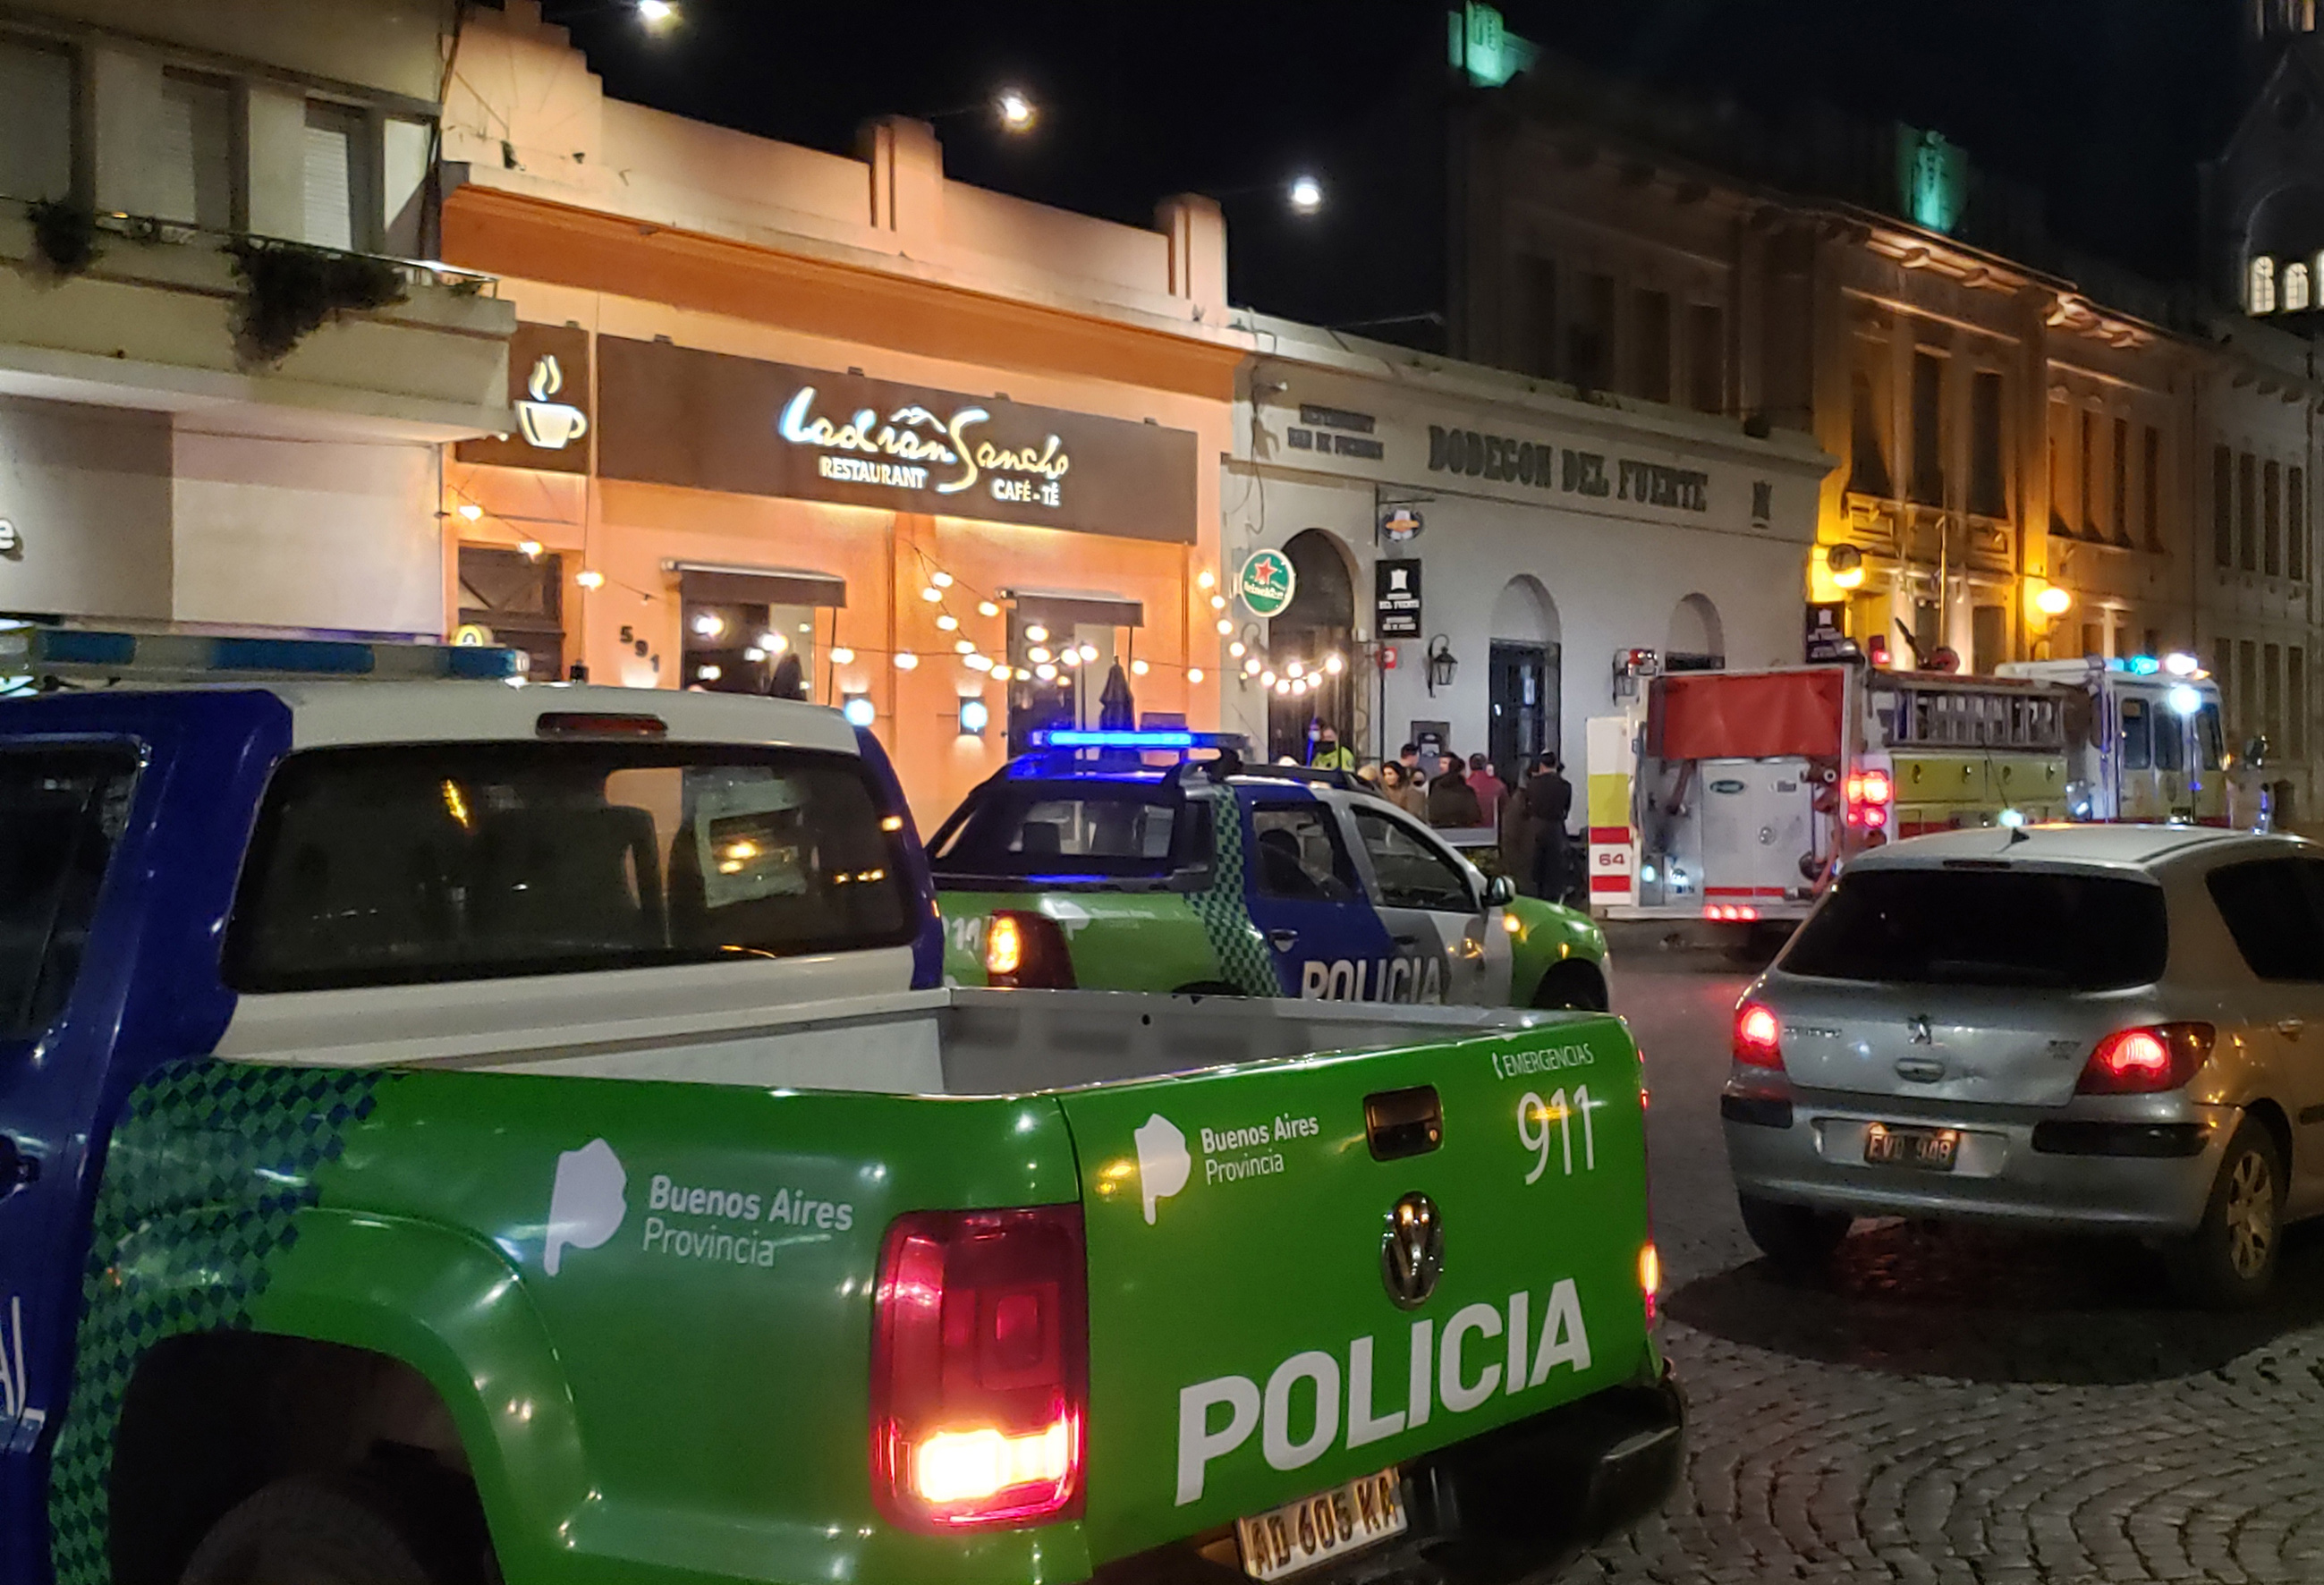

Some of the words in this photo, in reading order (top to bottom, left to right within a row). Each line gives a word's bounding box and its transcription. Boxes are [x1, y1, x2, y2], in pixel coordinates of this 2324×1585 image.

[818, 454, 929, 489] RESTAURANT
[1562, 448, 1609, 497] DEL
[619, 624, 660, 674] 591
[1599, 852, 1626, 867] 64
[1302, 957, 1442, 1005] POLICIA
[1502, 1043, 1595, 1077] EMERGENCIAS
[1200, 1123, 1270, 1154] Buenos
[1274, 1114, 1319, 1140] Aires
[1517, 1084, 1595, 1186] 911
[1204, 1148, 1285, 1186] Provincia
[649, 1174, 761, 1220] Buenos
[768, 1187, 854, 1231] Aires
[641, 1217, 776, 1267] Provincia
[1175, 1277, 1592, 1507] POLICIA
